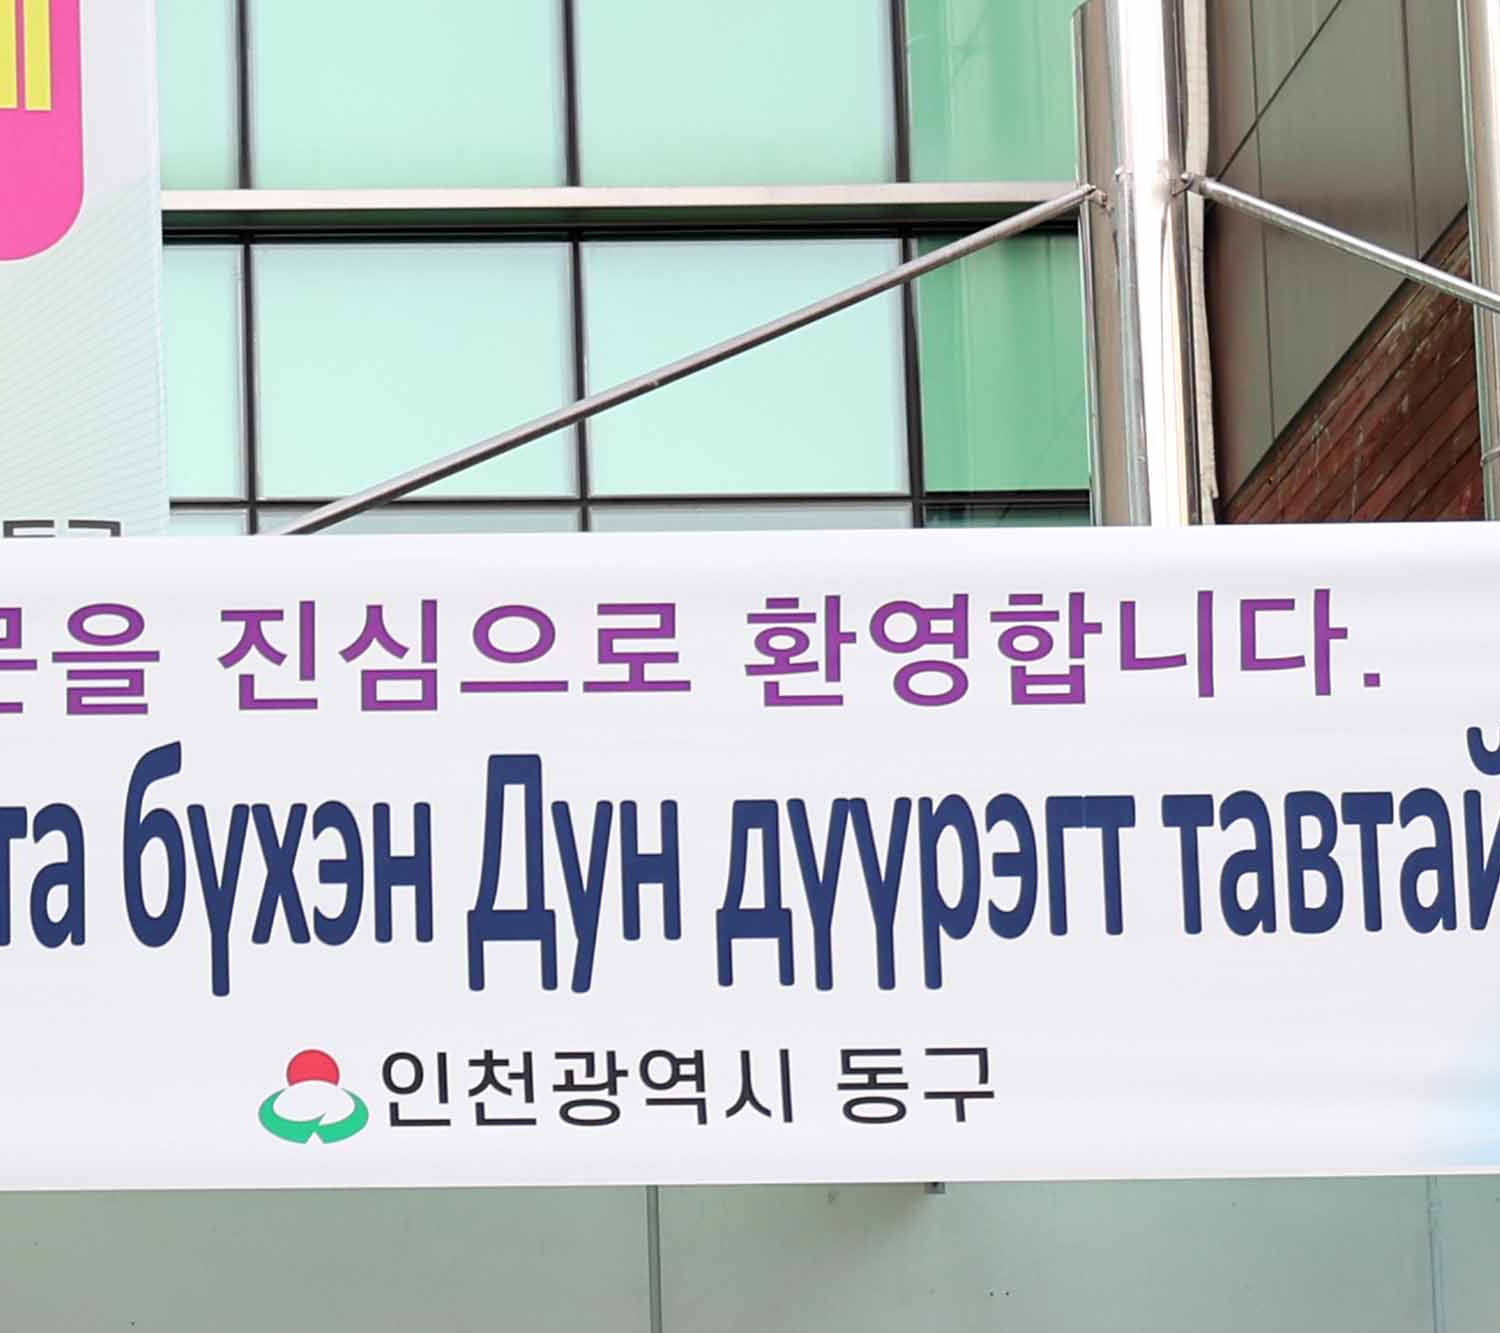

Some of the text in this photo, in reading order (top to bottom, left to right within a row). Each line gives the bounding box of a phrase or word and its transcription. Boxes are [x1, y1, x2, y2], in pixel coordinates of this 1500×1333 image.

[223, 600, 691, 711] 진심으로
[748, 591, 1380, 706] 환영합니다.
[123, 741, 433, 997] бүхэн
[467, 754, 681, 993] Дун
[716, 793, 1136, 991] дүүрэгт
[383, 1047, 995, 1127] 인천광역시 동구
